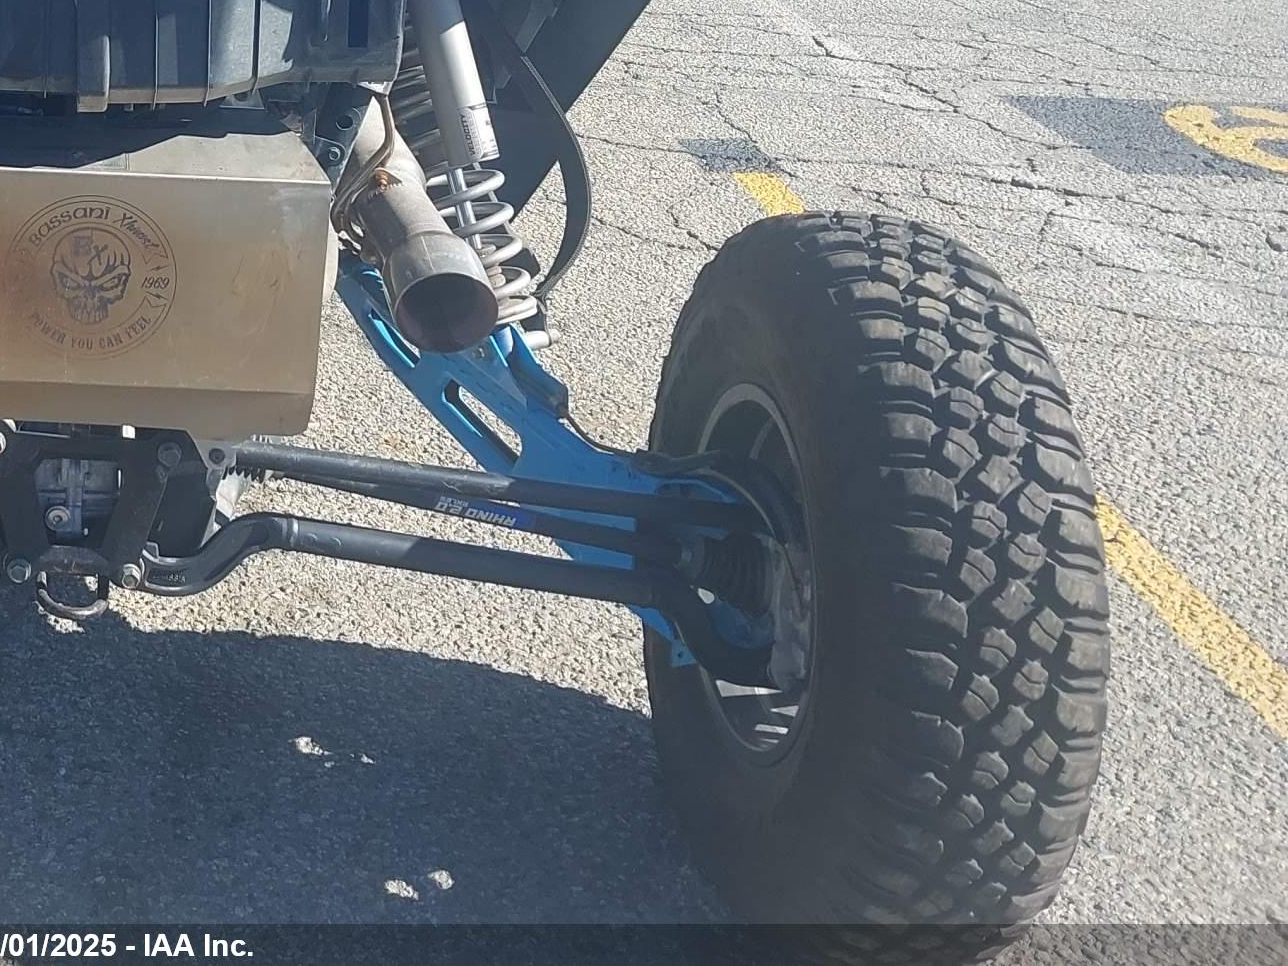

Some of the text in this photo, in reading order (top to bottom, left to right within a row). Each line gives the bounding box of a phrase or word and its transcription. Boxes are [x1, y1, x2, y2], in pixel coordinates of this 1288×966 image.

[460, 114, 475, 155] VELOCITY
[141, 276, 170, 290] 1969
[71, 337, 93, 350] YOU
[99, 332, 123, 349] CAN
[125, 315, 151, 340] FEEL
[465, 508, 516, 525] RHINO
